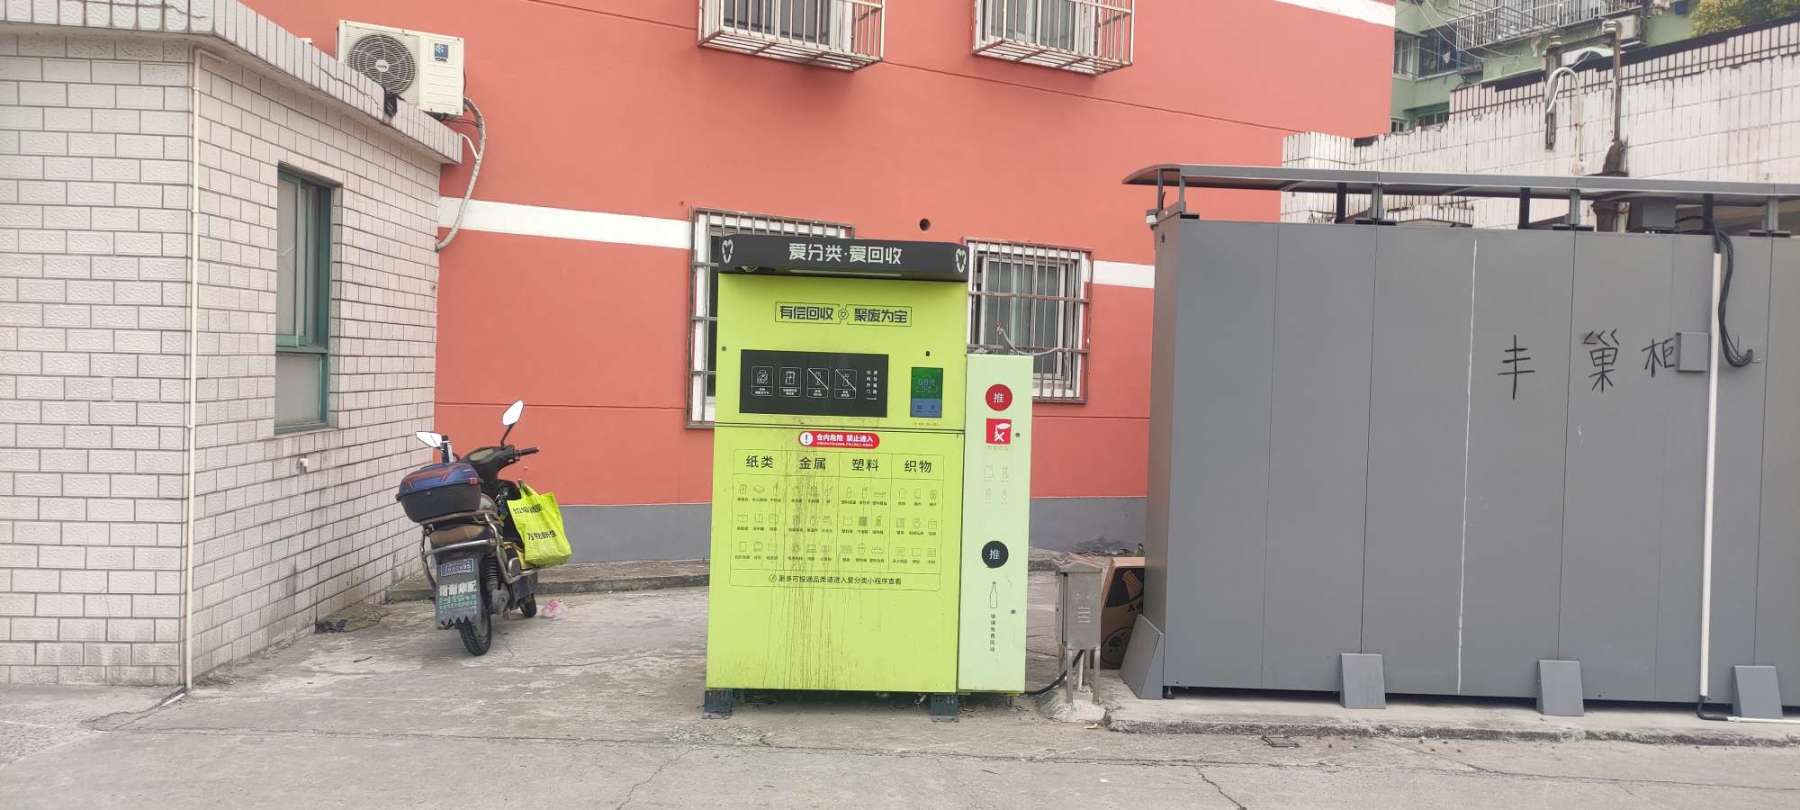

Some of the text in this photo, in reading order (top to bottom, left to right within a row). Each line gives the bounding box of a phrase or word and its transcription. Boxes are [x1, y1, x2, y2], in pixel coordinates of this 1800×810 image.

[788, 242, 903, 265] 爱分类·爱回收
[779, 305, 908, 323] 有偿回收 聚废为宝
[1497, 328, 1676, 400] 丰巢柜
[992, 391, 1005, 404] 推
[846, 433, 874, 443] 禁止进入
[745, 455, 774, 469] 纸类
[799, 456, 826, 470] 金属
[851, 458, 880, 472] 塑料
[904, 459, 932, 473] 织物
[988, 549, 1001, 560] 推
